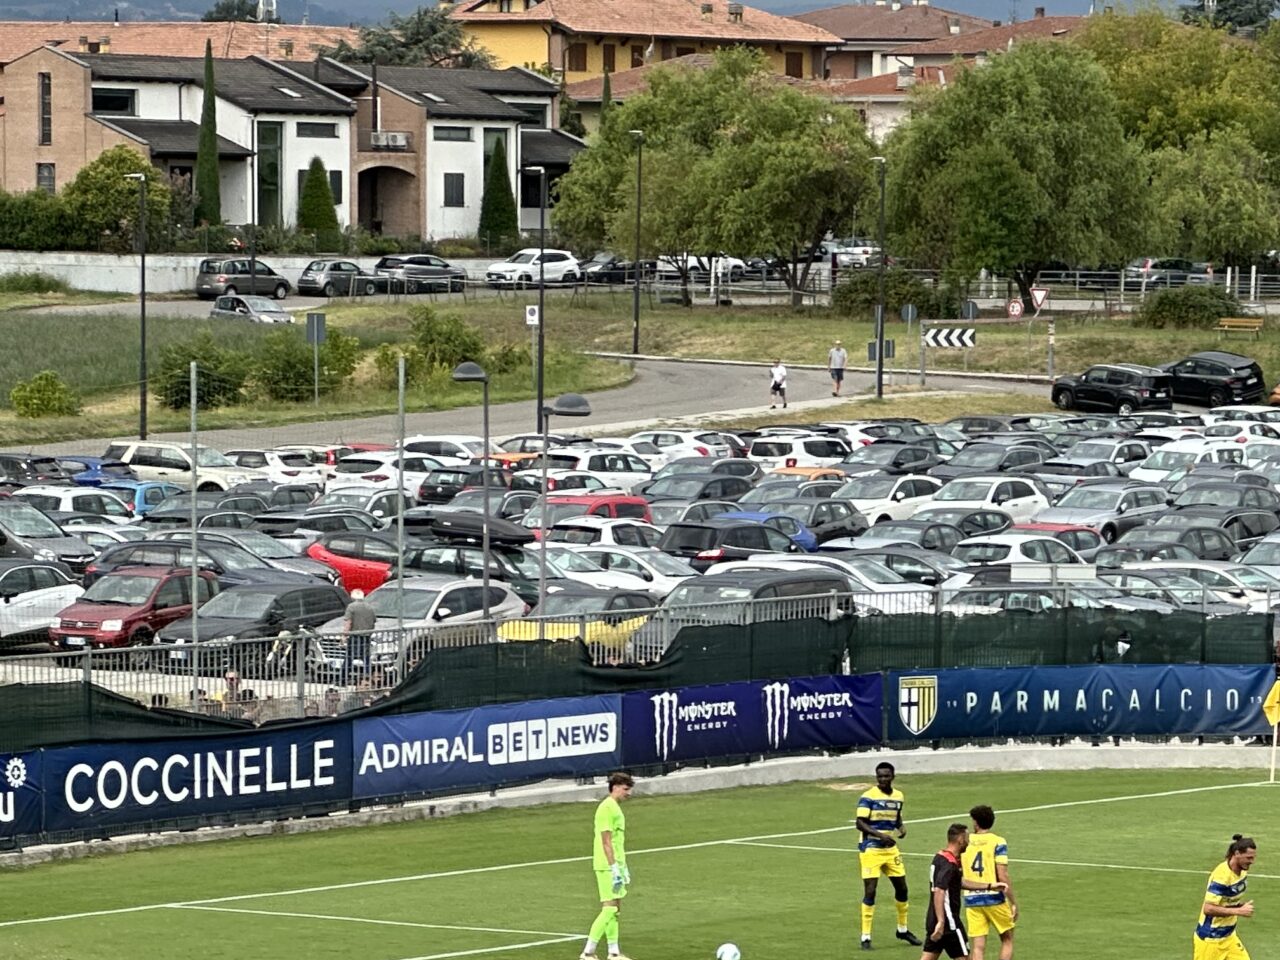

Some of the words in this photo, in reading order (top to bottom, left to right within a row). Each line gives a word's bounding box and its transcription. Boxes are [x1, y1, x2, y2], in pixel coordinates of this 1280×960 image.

[678, 701, 737, 721] MONSTER
[790, 692, 853, 711] MONSTER
[799, 711, 842, 721] ENERGY
[687, 721, 728, 731] ENERGY
[65, 739, 334, 812] COCCINELLE
[971, 851, 984, 878] 4
